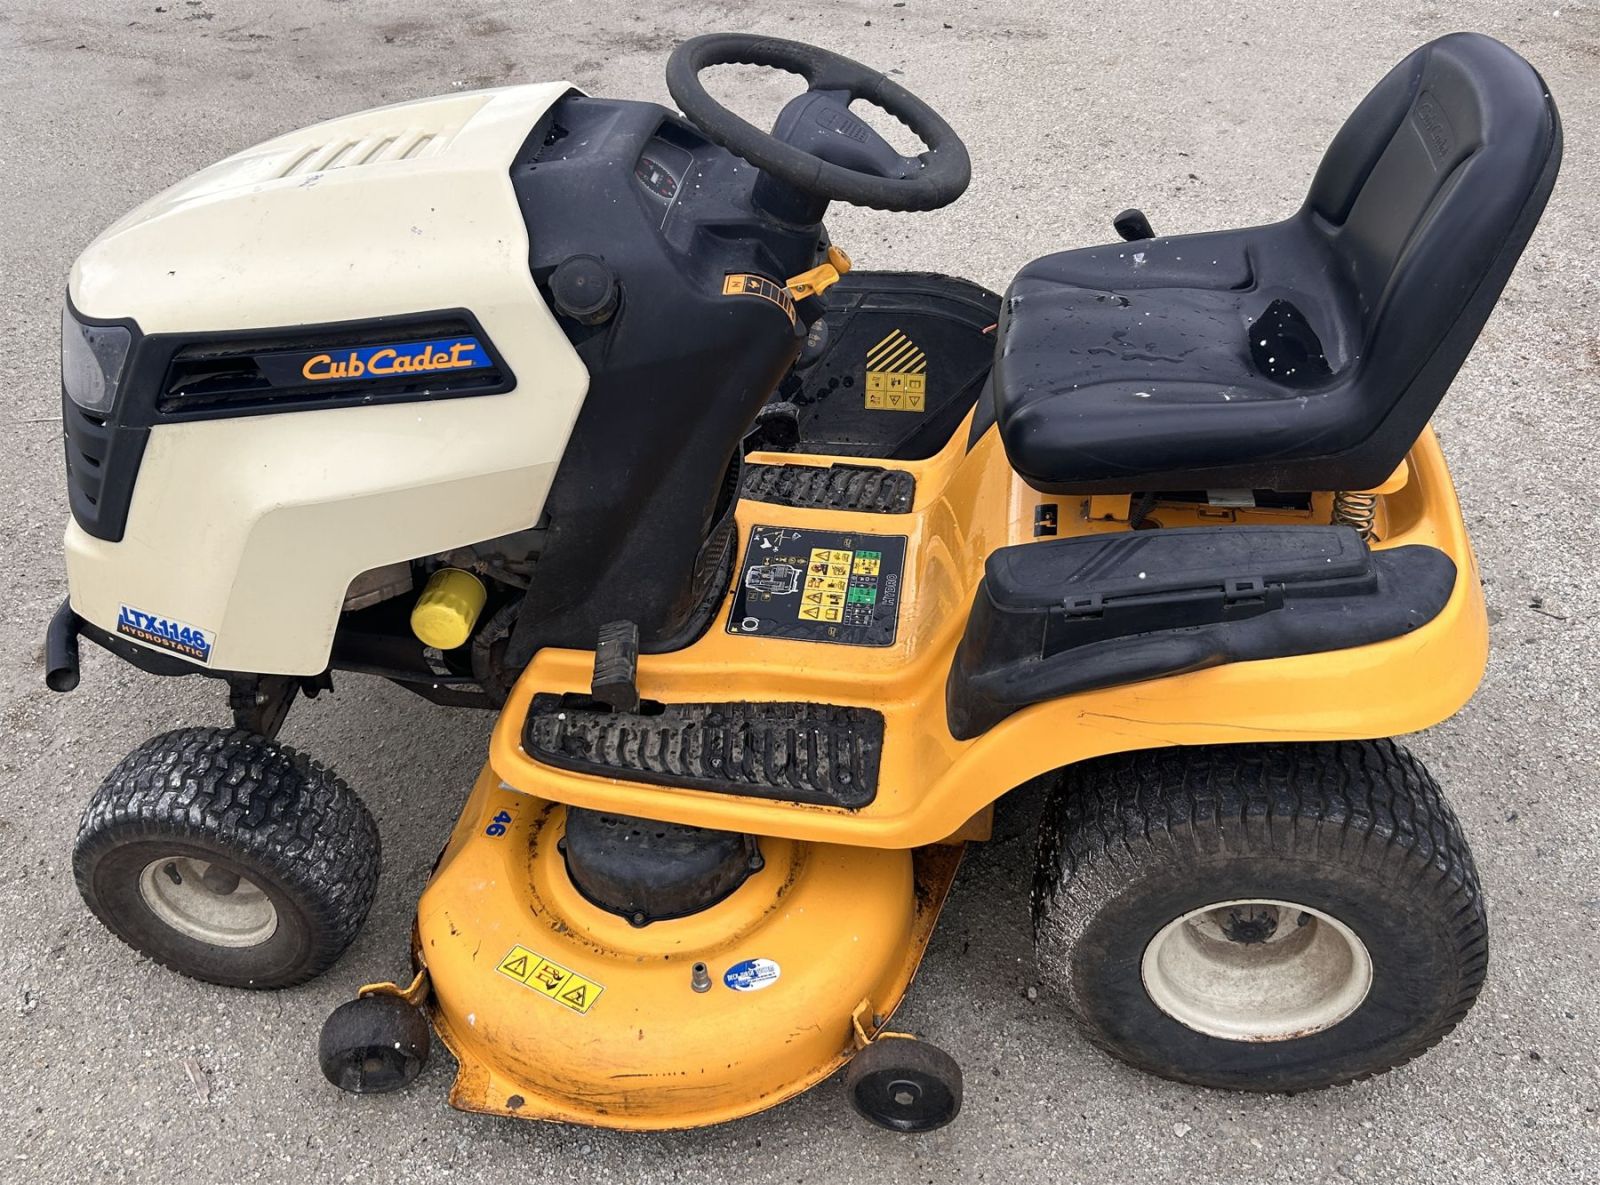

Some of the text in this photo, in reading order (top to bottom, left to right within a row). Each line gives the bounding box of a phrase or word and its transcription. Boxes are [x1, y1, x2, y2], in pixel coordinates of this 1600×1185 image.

[302, 343, 476, 380] Cub Cadet
[881, 573, 898, 606] HYDRO
[122, 624, 204, 657] HYDROSTATIC
[485, 810, 512, 837] 46
